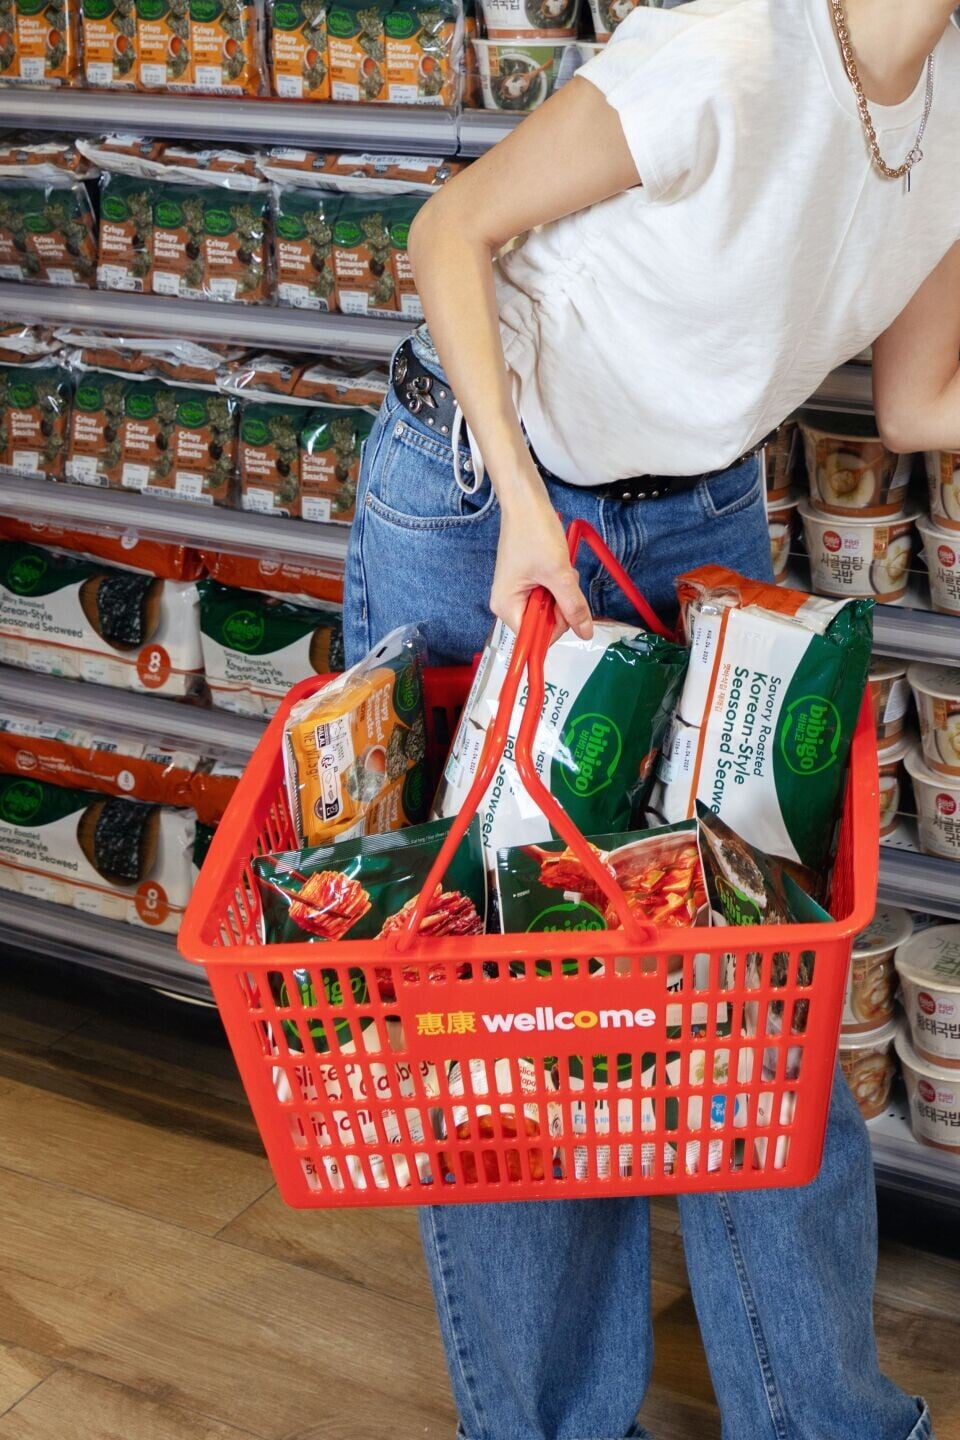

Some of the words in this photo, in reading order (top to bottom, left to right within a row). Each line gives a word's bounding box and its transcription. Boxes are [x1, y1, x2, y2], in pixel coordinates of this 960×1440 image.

[149, 651, 161, 671] 8
[550, 688, 570, 728] Savor
[718, 666, 749, 755] Seasoned
[763, 676, 782, 723] Savory
[734, 672, 768, 786] Korean-Style
[753, 726, 772, 778] Roasted
[796, 703, 828, 770] bibigo
[574, 722, 611, 792] bibigo
[711, 758, 732, 816] Seawe
[146, 888, 158, 909] 8
[415, 1010, 477, 1036] 惠康
[481, 1006, 656, 1034] wellcome
